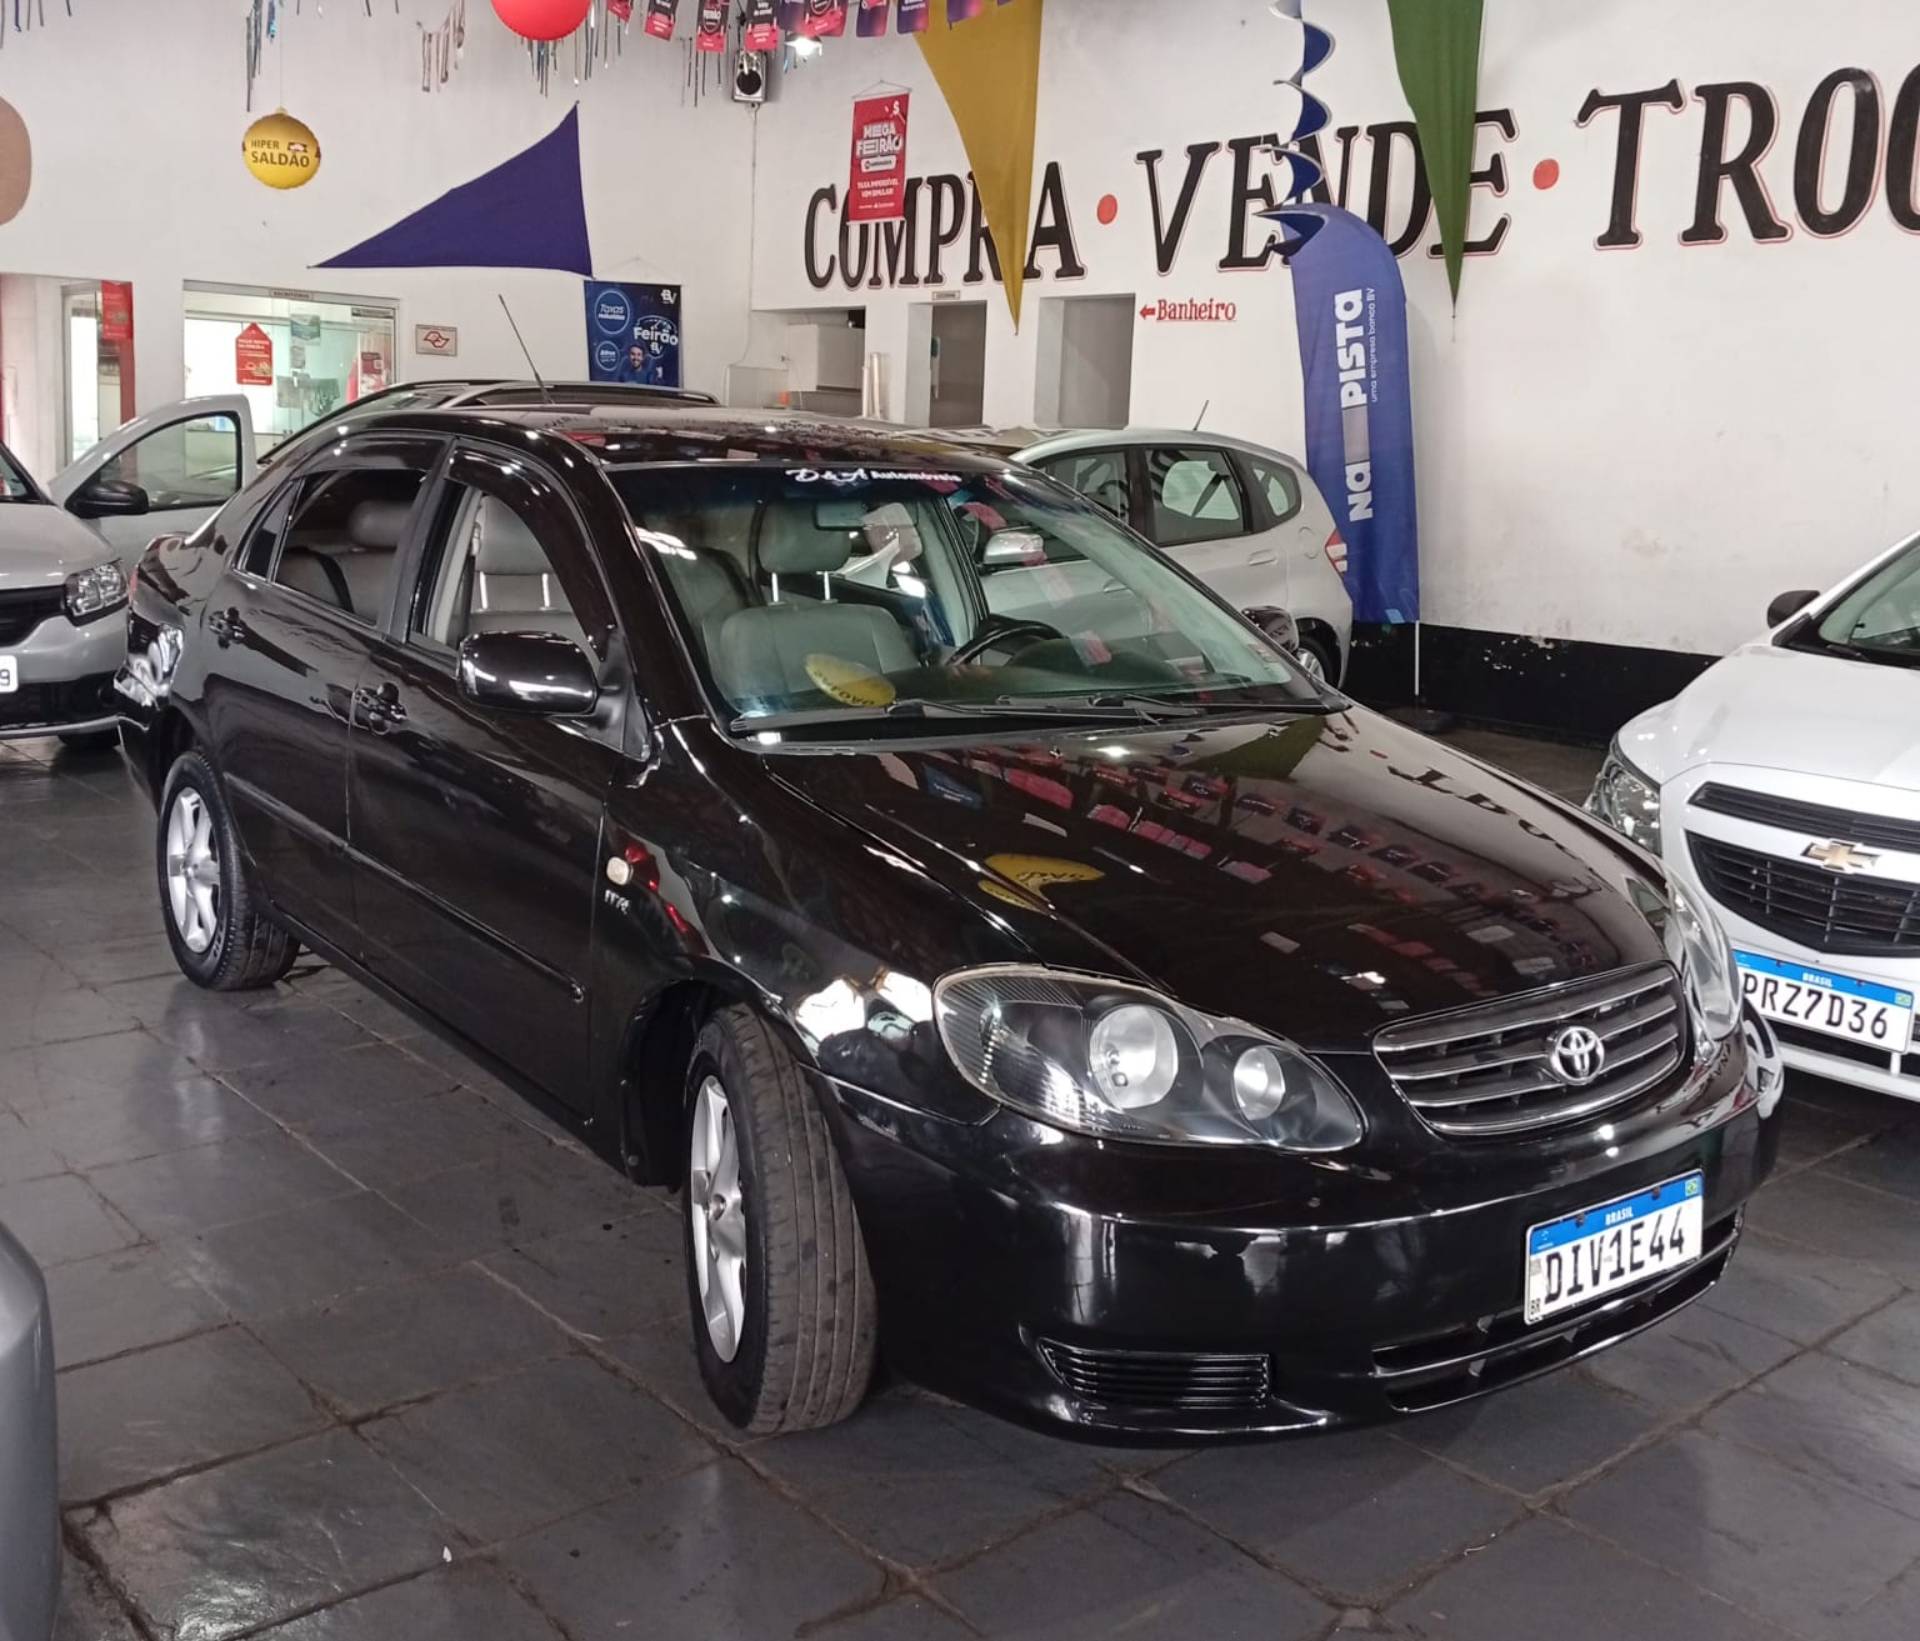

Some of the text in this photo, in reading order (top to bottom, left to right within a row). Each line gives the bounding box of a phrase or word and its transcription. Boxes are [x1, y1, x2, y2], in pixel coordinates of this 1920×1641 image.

[863, 121, 896, 139] MEGA
[251, 139, 280, 150] HIPER
[1156, 298, 1236, 320] Banheiro
[1367, 303, 1376, 334] banco
[633, 325, 678, 345] Feirão
[1801, 972, 1833, 988] BRASIL
[1743, 973, 1888, 1039] PRZ7D36
[1605, 1207, 1633, 1225] BRASIL
[1545, 1206, 1684, 1305] DIV1E44
